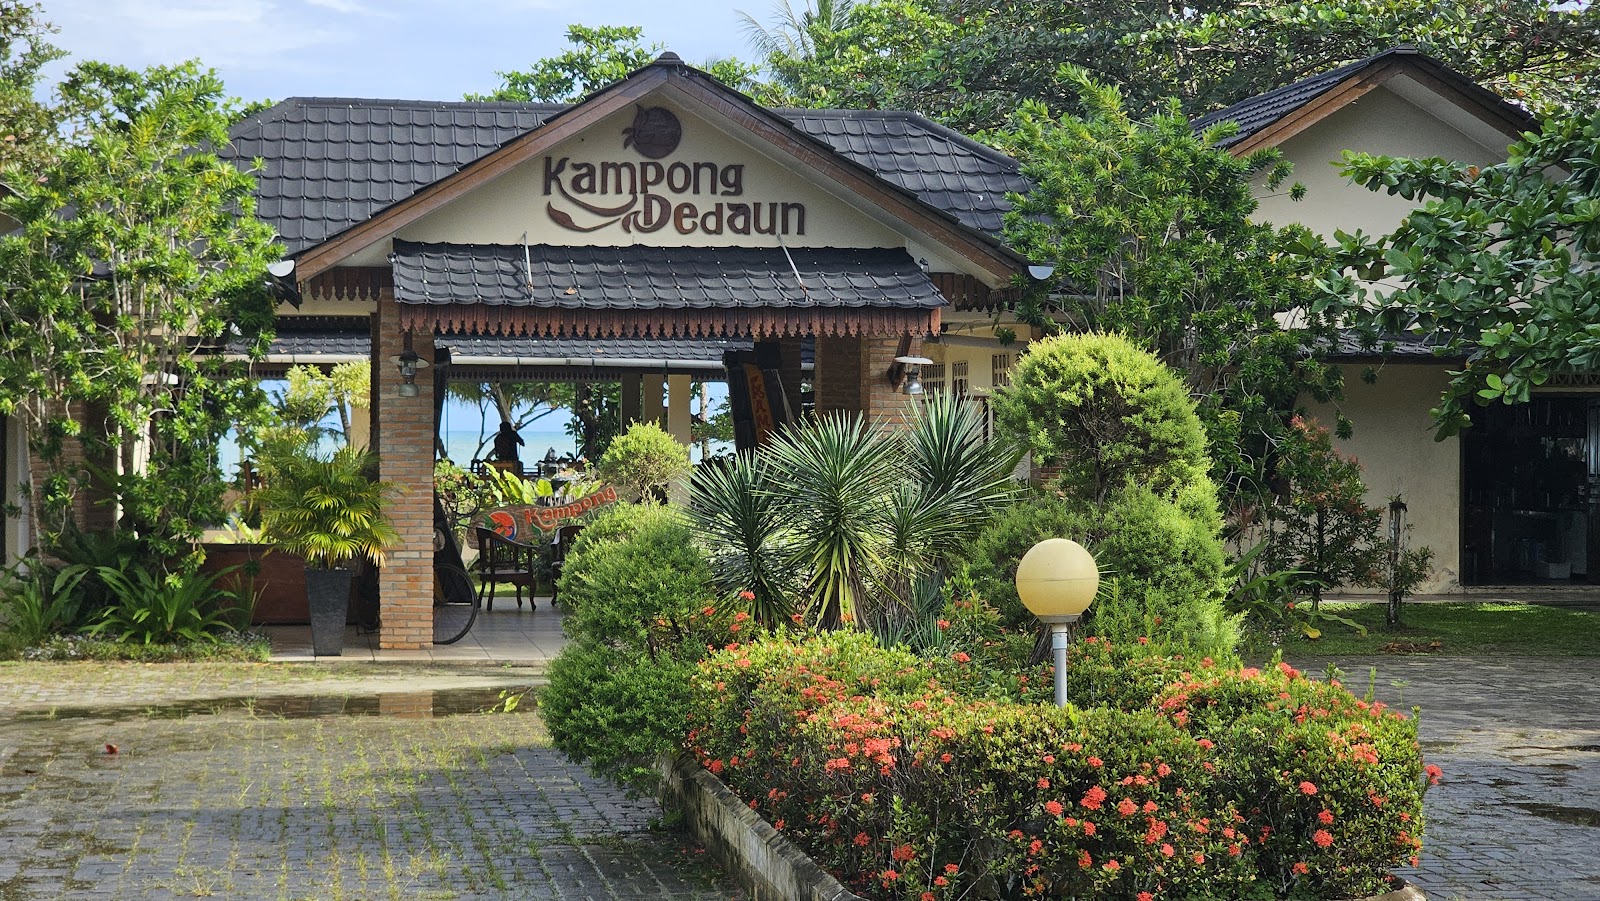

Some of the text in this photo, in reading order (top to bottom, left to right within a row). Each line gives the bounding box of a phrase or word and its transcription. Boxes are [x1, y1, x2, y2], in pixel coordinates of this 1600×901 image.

[543, 157, 744, 200] Kampong
[624, 194, 806, 235] Dedaun
[524, 486, 618, 530] Kampong
